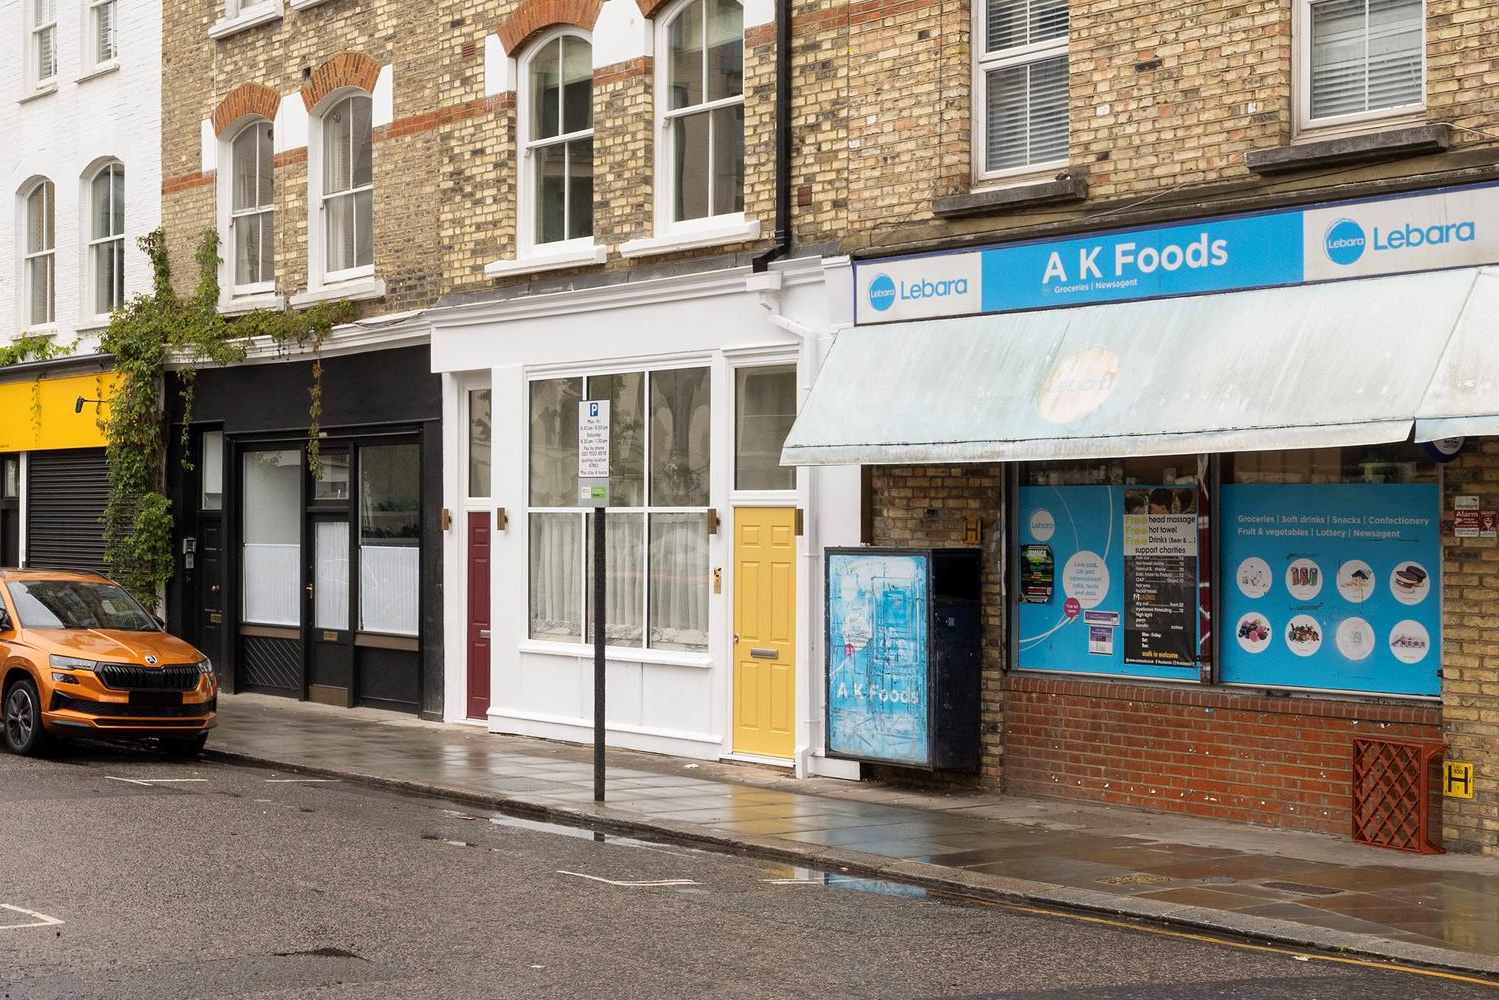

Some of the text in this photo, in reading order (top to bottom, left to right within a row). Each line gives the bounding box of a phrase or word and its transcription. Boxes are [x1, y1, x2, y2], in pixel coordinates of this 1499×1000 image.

[1328, 236, 1365, 249] Lebara
[1373, 220, 1476, 251] Lebara
[1042, 232, 1228, 284] A K Foods
[870, 288, 895, 298] Lebara
[900, 278, 968, 300] Lebara
[1054, 278, 1138, 294] Groceries Newsagent
[1124, 516, 1148, 524] Free
[1167, 516, 1196, 524] massage
[1238, 514, 1430, 526] Groceries Soft drinks Snacks Confectionery
[1265, 529, 1309, 537] vegetables
[1316, 529, 1346, 538] Lottery
[1354, 529, 1400, 538] Newsagent
[1124, 537, 1148, 545] Free
[836, 682, 918, 704] A K Foods
[1448, 764, 1468, 794] H
